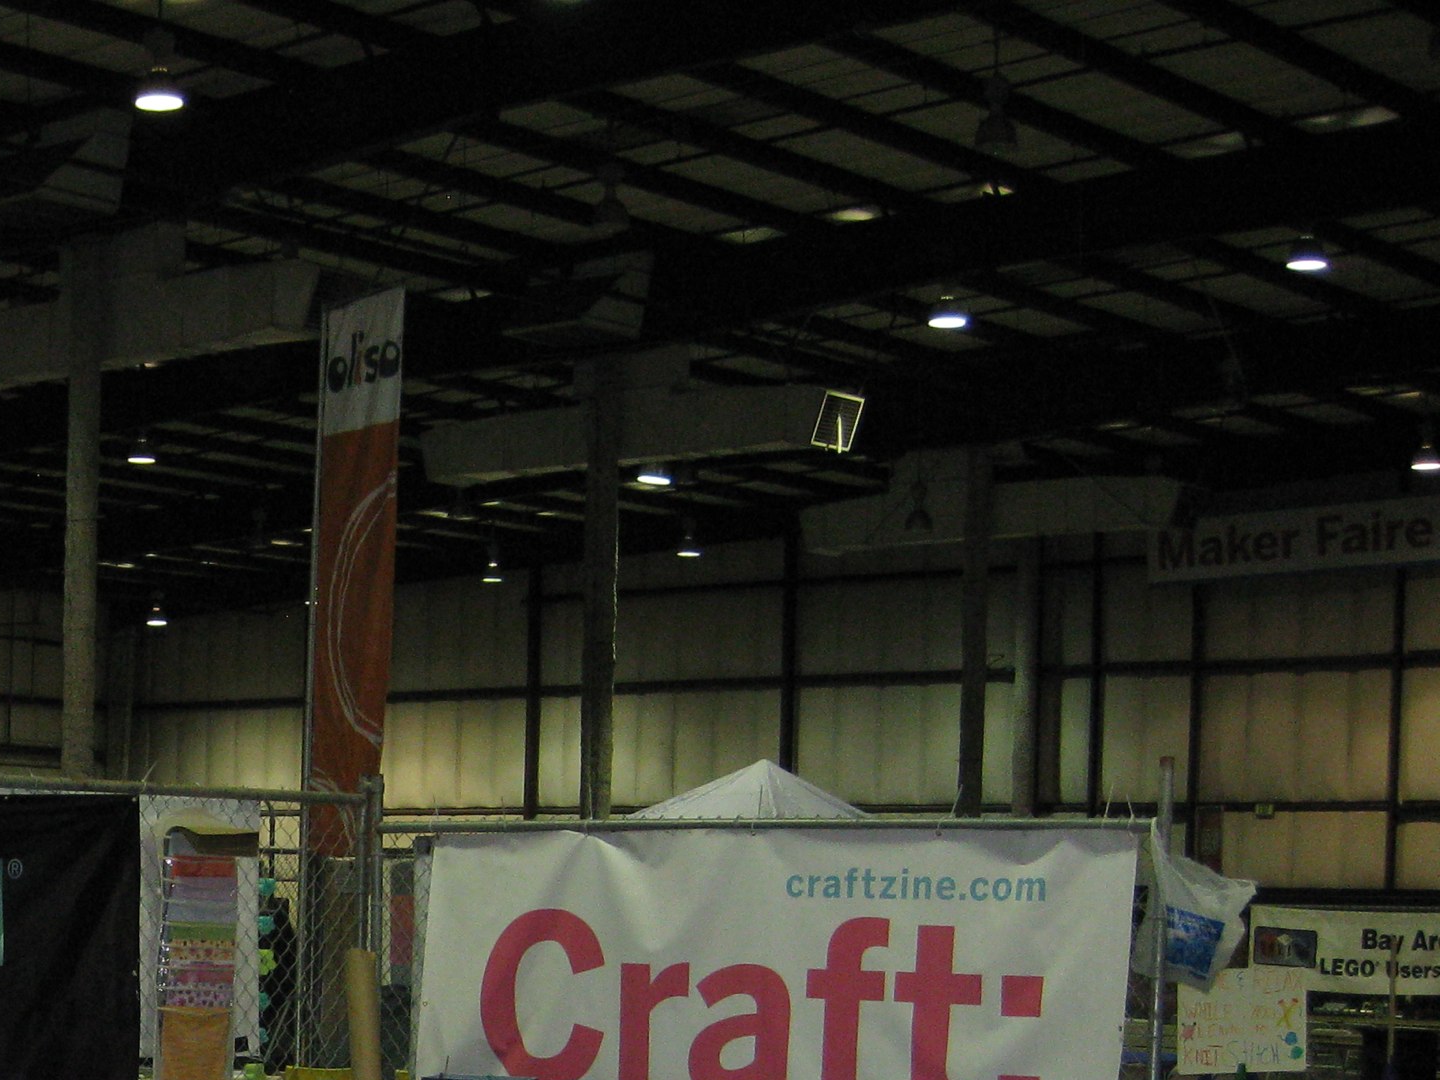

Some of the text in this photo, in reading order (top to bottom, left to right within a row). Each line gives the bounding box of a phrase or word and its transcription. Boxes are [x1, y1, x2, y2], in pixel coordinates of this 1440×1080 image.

[1158, 510, 1433, 570] Maker Faire
[786, 868, 1047, 902] craftzine.com
[1361, 928, 1440, 954] Bay Ar
